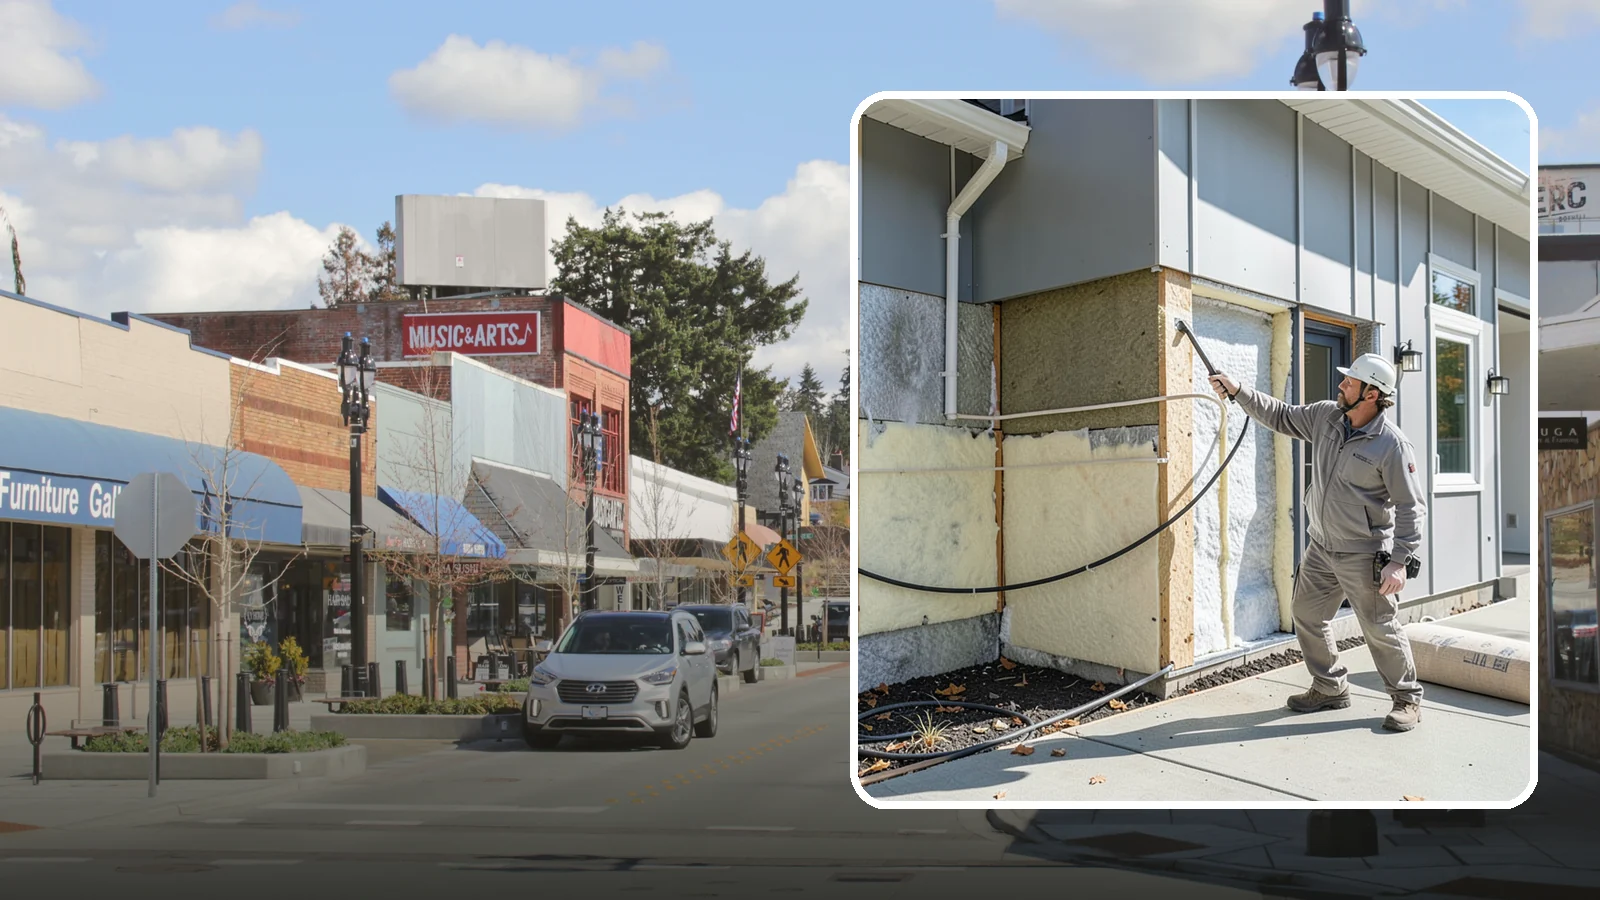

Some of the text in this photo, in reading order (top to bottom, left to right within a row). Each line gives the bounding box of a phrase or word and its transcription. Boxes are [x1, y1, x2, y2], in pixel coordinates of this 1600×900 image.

[0, 472, 121, 519] Furniture Gal
[453, 563, 480, 574] SUSHI
